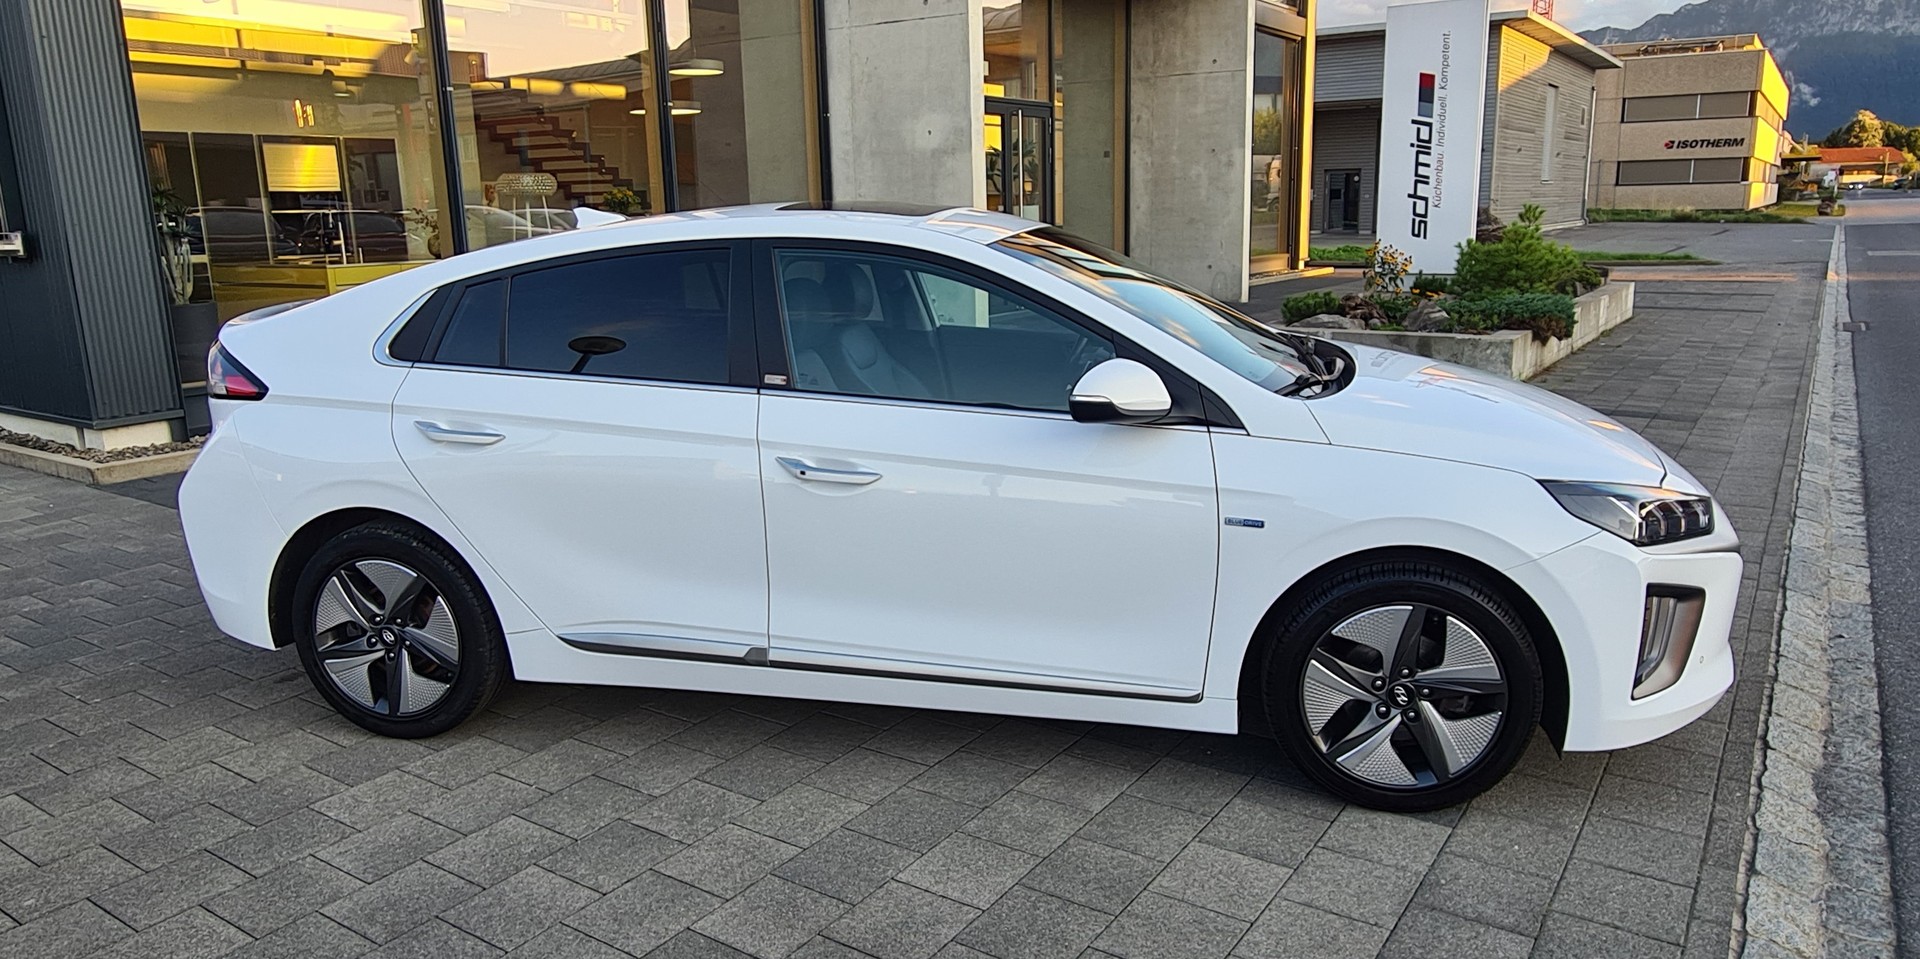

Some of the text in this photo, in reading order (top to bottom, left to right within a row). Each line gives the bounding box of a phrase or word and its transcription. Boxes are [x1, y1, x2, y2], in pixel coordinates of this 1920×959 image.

[1407, 118, 1434, 241] schmid
[1431, 30, 1452, 209] Küchenbau. Individuell. Kompetent.
[1676, 137, 1746, 149] ISOTHERM
